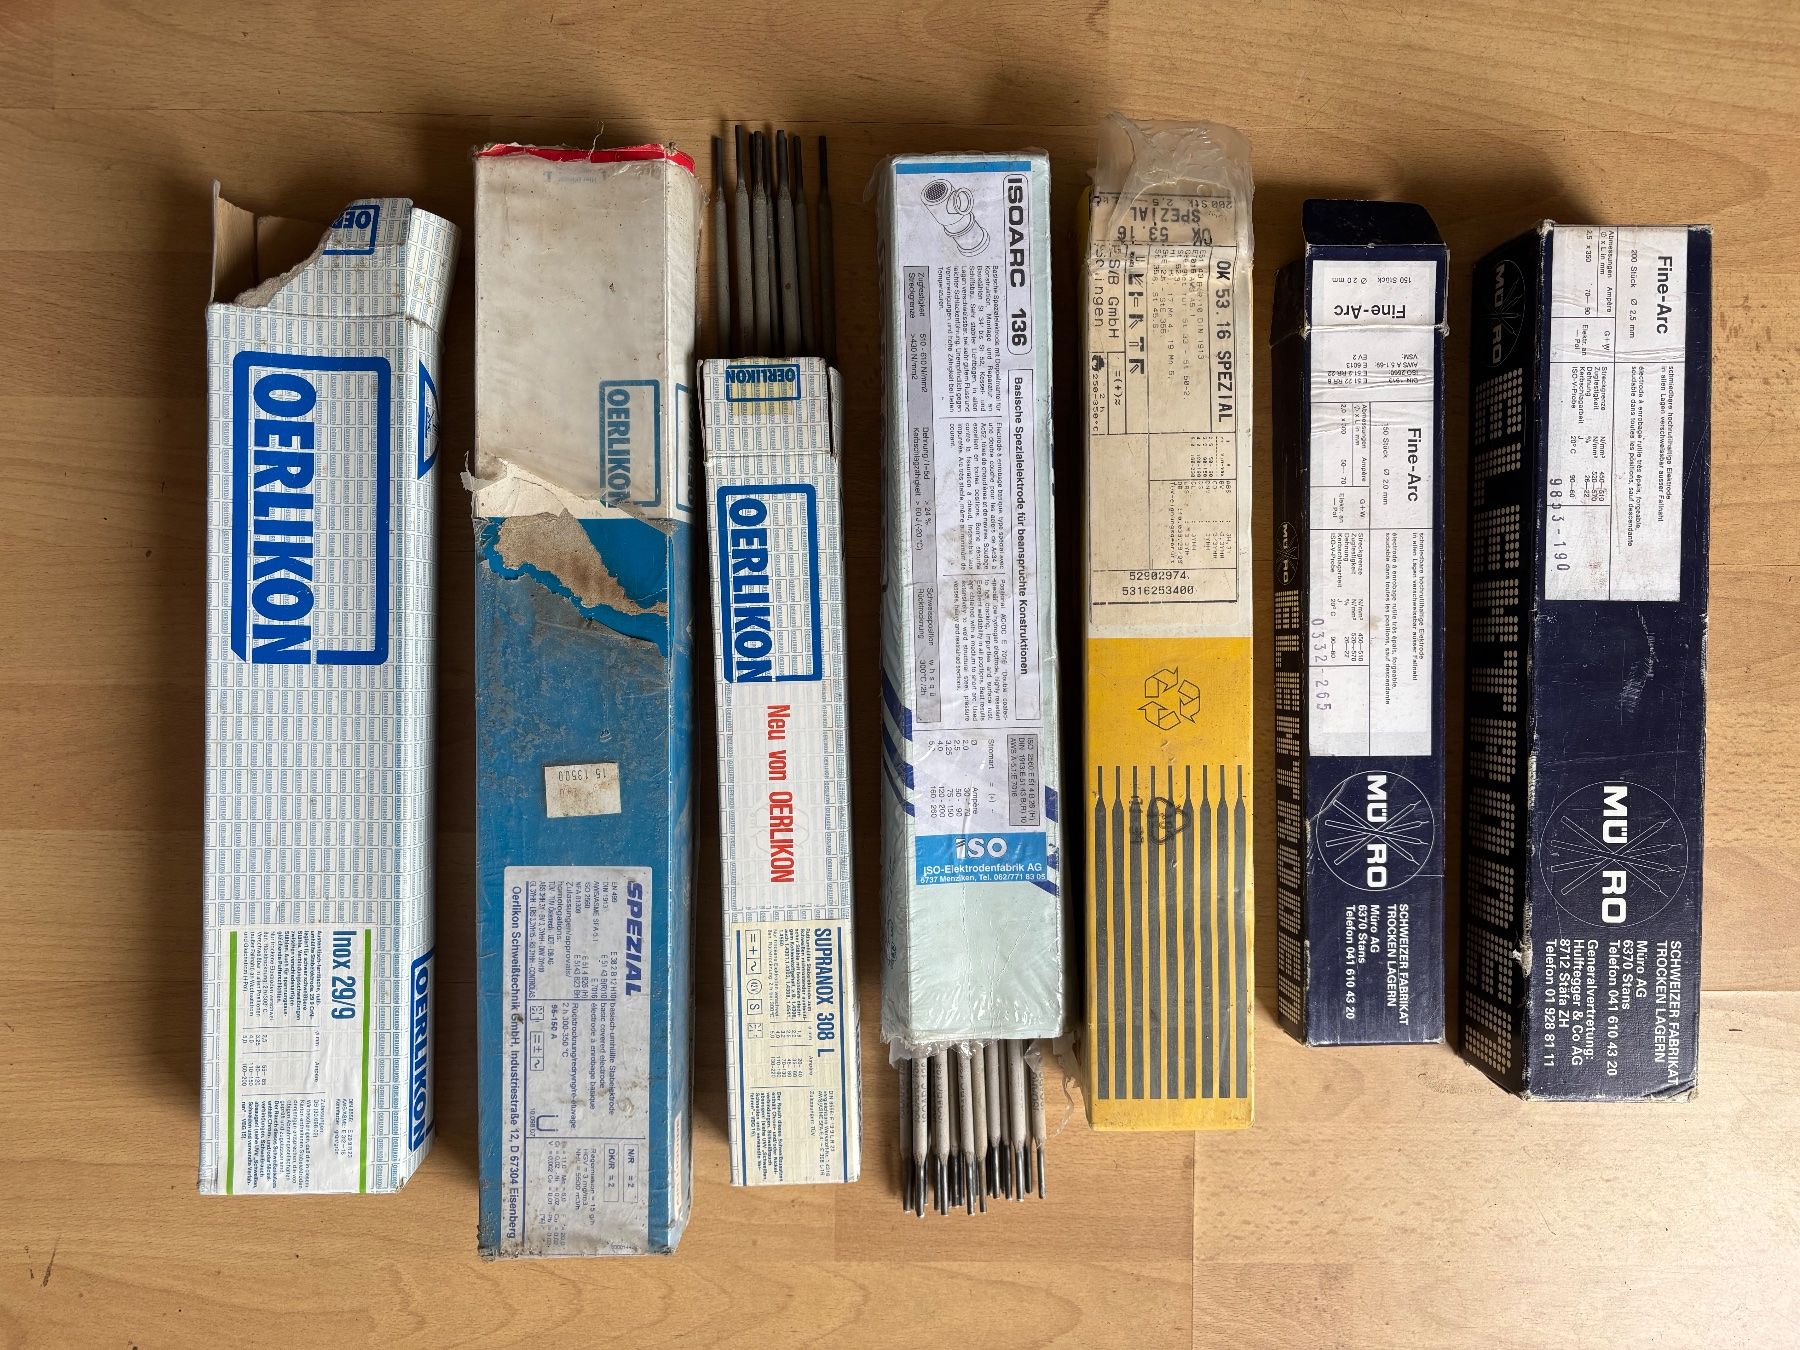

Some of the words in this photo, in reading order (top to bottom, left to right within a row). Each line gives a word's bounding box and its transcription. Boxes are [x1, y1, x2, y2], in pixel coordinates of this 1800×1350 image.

[1130, 207, 1200, 223] SPEZIAL
[1007, 178, 1025, 288] ISOARC
[1117, 226, 1168, 242] 53.16
[1192, 228, 1212, 246] OK
[1216, 260, 1231, 280] OK
[1607, 230, 1615, 278] Abmessungen
[1630, 266, 1638, 288] Stück
[908, 272, 916, 319] Streckgrenze
[917, 272, 926, 317] Zugfestigkeit
[1334, 304, 1406, 319] Fine-Arc
[1657, 256, 1672, 334] Fine-Arc
[1011, 308, 1027, 347] 136
[1108, 297, 1120, 338] GmbH
[1216, 288, 1232, 340] 53.16
[1629, 325, 1636, 339] mm
[726, 368, 795, 383] OERLIKON
[1217, 351, 1232, 423] SPEZIAL
[1592, 366, 1600, 410] Zugfestigkeit
[1014, 377, 1023, 423] Basische
[607, 389, 631, 508] OERLIKON
[1407, 428, 1421, 502] Fine-Arc
[1014, 427, 1025, 510] Spezialelektrode
[1383, 492, 1388, 505] mm
[252, 373, 316, 664] OERLIKON
[1017, 512, 1025, 526] für
[1016, 528, 1028, 597] beanspruchte
[1129, 571, 1188, 580] 52902974
[729, 498, 774, 683] OERLIKON
[1122, 586, 1195, 595] 5316253400
[926, 587, 935, 646] Schweissposition
[1019, 599, 1030, 675] Konstruktionen
[767, 704, 791, 741] Neu
[768, 749, 790, 781] von
[971, 787, 980, 815] Ampère
[768, 790, 795, 883] OERLIKON
[923, 863, 1024, 876] ISO-Elektrodenfabrik
[1027, 863, 1042, 871] AG
[511, 886, 521, 928] Oerlikon
[1357, 904, 1368, 930] 6370
[1369, 904, 1380, 930] Müro
[626, 881, 642, 996] SPEZIAL
[1345, 905, 1355, 944] Telefon
[1386, 904, 1397, 958] TROCKEN
[1399, 903, 1409, 969] SCHWEIZER
[332, 930, 357, 970] Inox
[1345, 947, 1355, 965] 041
[1357, 933, 1367, 964] Stans
[1369, 933, 1380, 953] AG
[1559, 938, 1571, 968] 8712
[1622, 939, 1634, 969] 6370
[1636, 940, 1649, 975] Müro
[510, 931, 521, 1010] Schweißtechnik
[814, 928, 834, 1005] SUPRANOX
[1345, 968, 1355, 988] 610
[1544, 938, 1557, 985] Telefon
[1571, 939, 1584, 1007] Hulftegger
[1607, 939, 1620, 986] Telefon
[1655, 940, 1668, 1004] TROCKEN
[1386, 961, 1396, 1006] LAGERN
[1545, 989, 1556, 1003] 01
[1557, 972, 1571, 1006] Stäfa
[1621, 973, 1633, 1010] Stans
[1635, 978, 1648, 997] AG
[1668, 940, 1682, 1018] SCHWEIZER
[331, 976, 356, 1019] 29/9
[1345, 991, 1355, 1003] 43
[1345, 1006, 1355, 1020] 20
[1398, 972, 1409, 1025] FABRIKAT
[1584, 939, 1598, 1060] Generalvertretung:
[1607, 989, 1620, 1012] 041
[510, 1013, 520, 1047] GmbH,
[817, 1012, 834, 1041] 308
[1544, 1007, 1556, 1030] 928
[1558, 1009, 1570, 1028] ZH
[1572, 1010, 1583, 1021] &
[1607, 1015, 1619, 1038] 610
[1544, 1033, 1555, 1051] 81
[1571, 1024, 1582, 1042] Co
[1606, 1041, 1619, 1057] 43
[1654, 1008, 1667, 1063] LAGERN
[413, 967, 430, 1148] OERLIKON
[589, 1045, 597, 1080] enrobage
[817, 1049, 834, 1057] L
[1543, 1053, 1555, 1066] 11
[1571, 1045, 1582, 1066] AG
[1606, 1060, 1618, 1076] 20
[1667, 1022, 1680, 1085] FABRIKAT
[510, 1050, 520, 1125] Industriestraße
[588, 1081, 596, 1110] basique
[608, 1065, 616, 1115] Stabelektrode
[509, 1128, 519, 1142] 12,
[510, 1145, 519, 1153] D
[509, 1155, 519, 1185] 67304
[627, 1148, 635, 1164] N/R
[507, 1187, 519, 1239] Eisenberg
